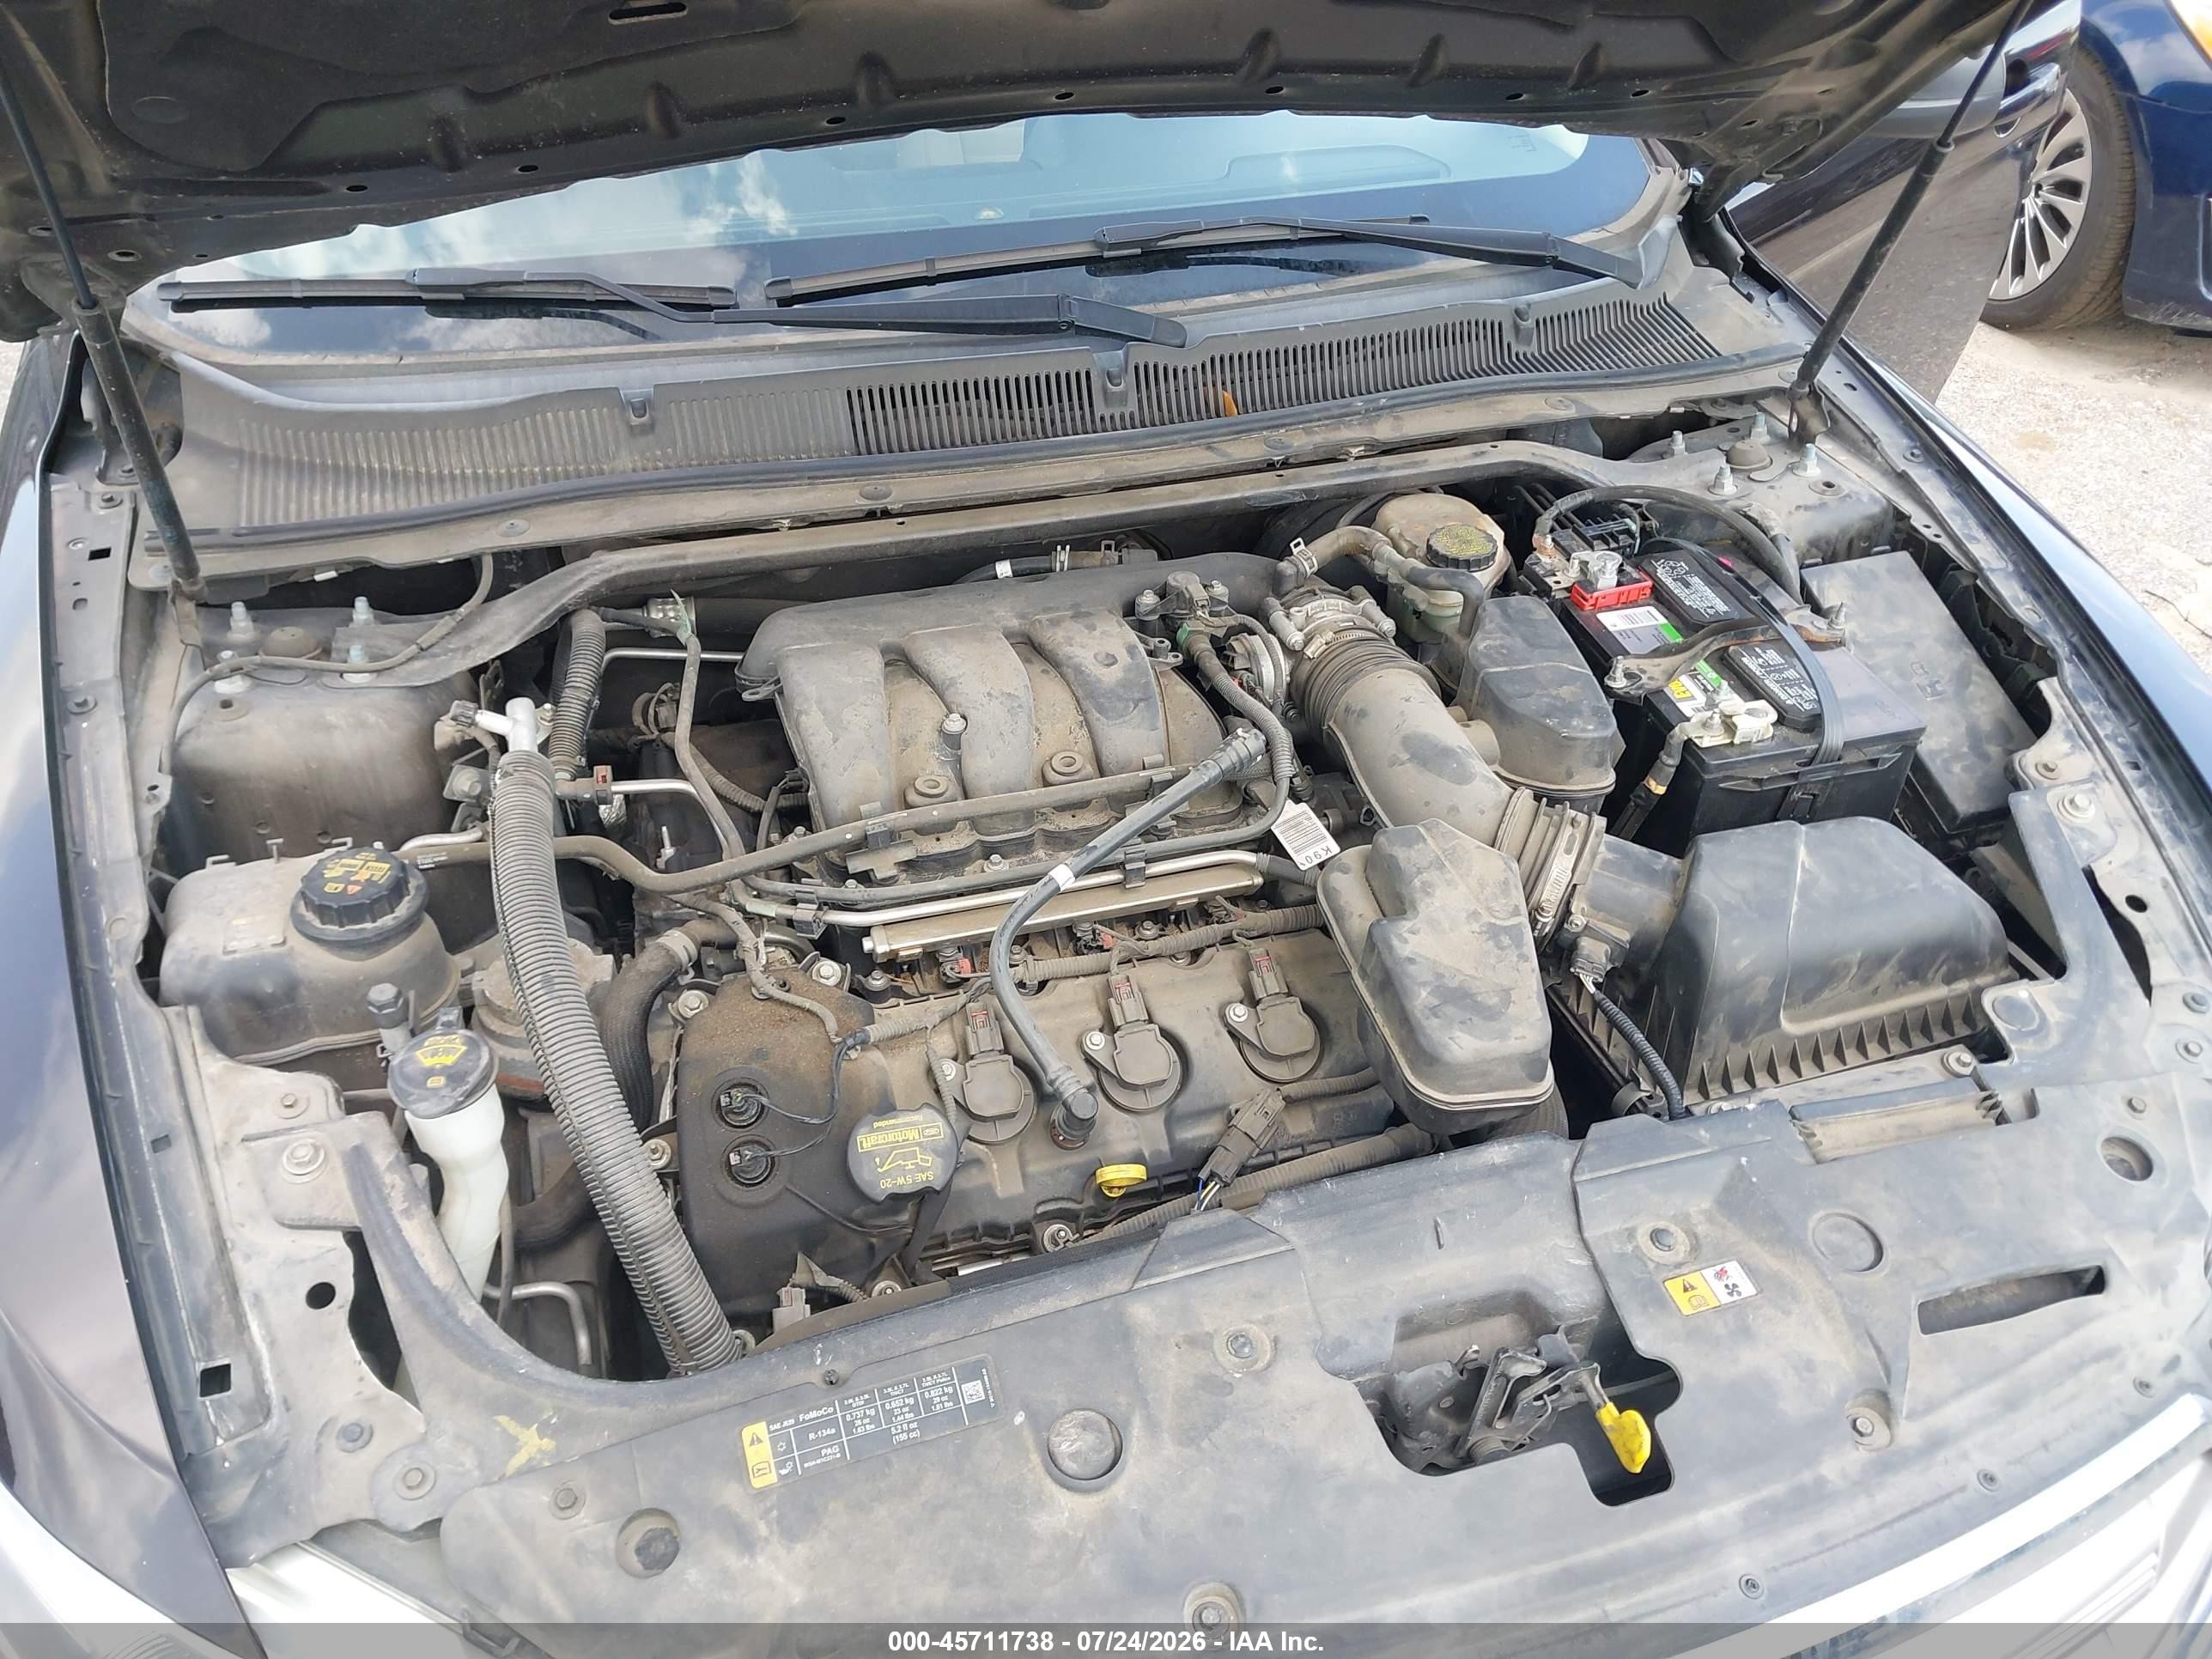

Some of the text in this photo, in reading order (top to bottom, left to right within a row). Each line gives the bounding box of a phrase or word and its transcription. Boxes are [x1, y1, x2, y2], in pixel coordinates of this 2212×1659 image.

[859, 1127, 921, 1148] Motorcraft
[880, 1171, 934, 1189] SAE 5W-20
[944, 1385, 953, 1395] kg
[884, 1396, 915, 1410] 0.652 kg
[769, 1421, 781, 1431] SAE
[799, 1406, 834, 1422] FoMoCo
[846, 1407, 876, 1422] 0.737 kg
[808, 1426, 836, 1441] R-134a
[890, 1425, 902, 1435] 5.2
[893, 1430, 921, 1445] (155 cc)
[821, 1445, 840, 1456] PAG
